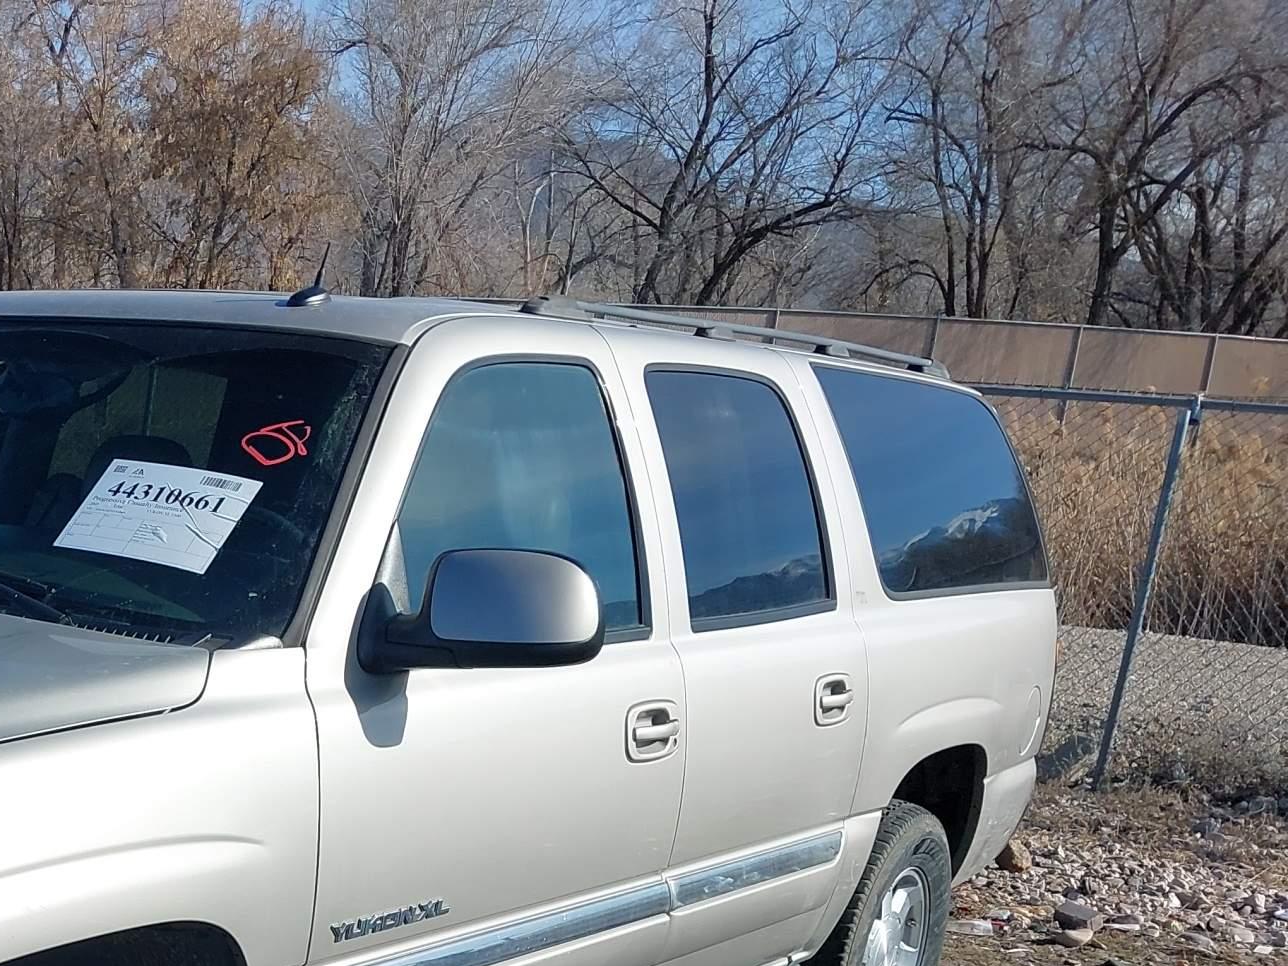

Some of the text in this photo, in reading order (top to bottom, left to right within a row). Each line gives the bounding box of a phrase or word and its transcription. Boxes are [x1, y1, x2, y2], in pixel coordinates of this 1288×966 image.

[107, 480, 226, 514] 44310661
[329, 898, 451, 944] YUKON XL
